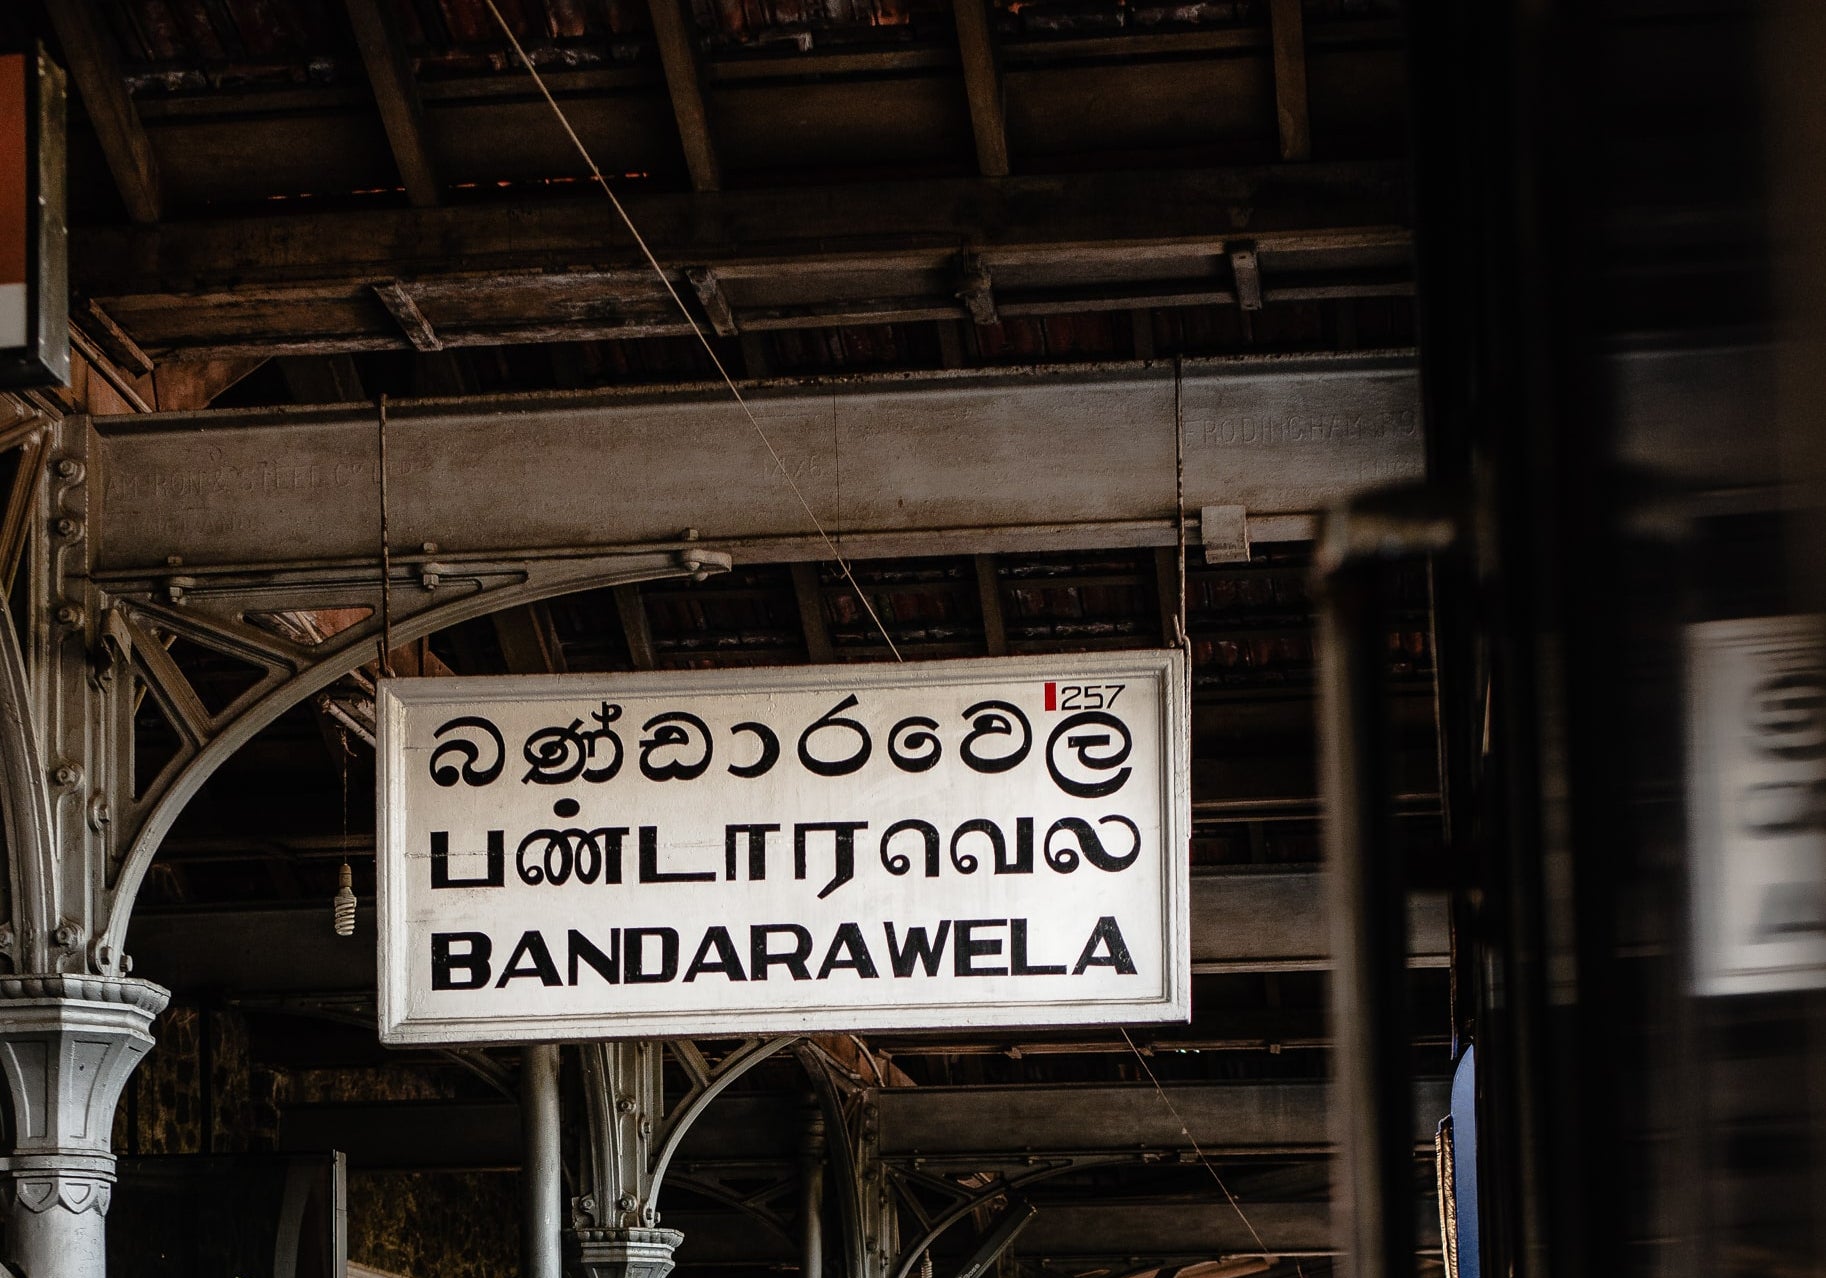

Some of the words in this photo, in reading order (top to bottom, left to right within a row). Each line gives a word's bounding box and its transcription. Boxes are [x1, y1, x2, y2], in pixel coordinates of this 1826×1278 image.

[1061, 684, 1126, 711] 257
[429, 693, 1133, 799] බණ්ඩාරවෙල
[430, 798, 1141, 900] பண்டாரவெல
[431, 916, 1138, 991] BANDARAWELA
